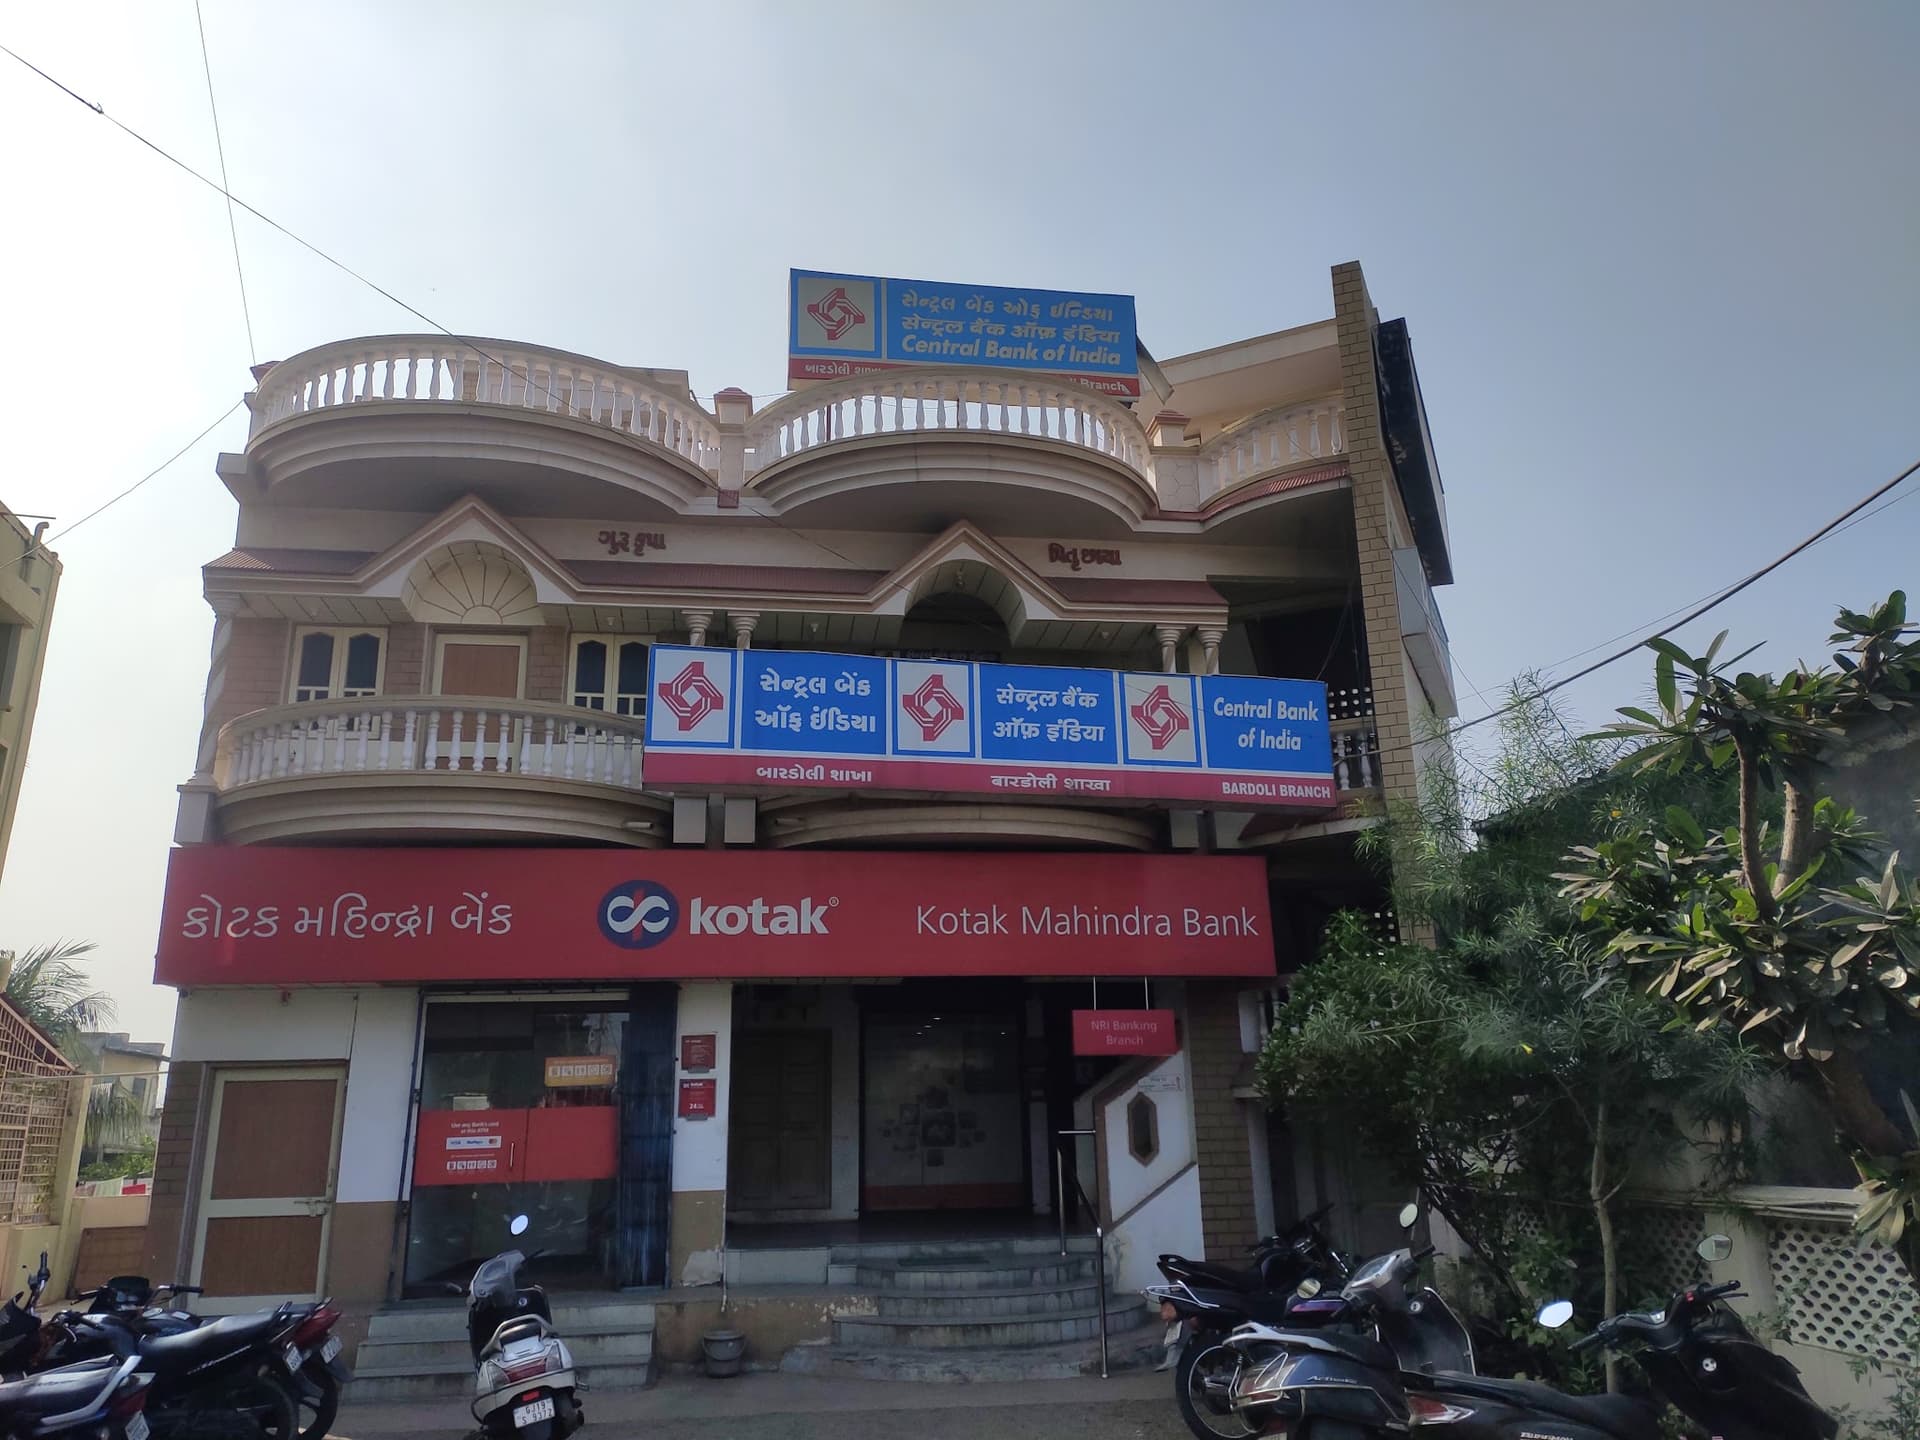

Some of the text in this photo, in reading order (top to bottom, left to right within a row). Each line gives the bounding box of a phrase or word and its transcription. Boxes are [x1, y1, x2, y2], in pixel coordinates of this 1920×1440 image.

[969, 317, 1007, 336] बैंक
[1062, 324, 1120, 344] इंडिया
[902, 334, 1121, 366] Central Bank of India
[804, 361, 850, 375] બારડોલી
[1080, 378, 1125, 392] Branch
[759, 667, 872, 699] સેન્ટ્રલ બેંક
[996, 683, 1099, 712] सेन्ट्रल बैंक
[1213, 696, 1320, 722] Central Bank
[755, 704, 876, 733] ઑફ ઈંડિયા
[1046, 718, 1106, 743] इंडिया
[1238, 727, 1302, 751] of India
[756, 764, 872, 783] બારડોલી શાખા
[990, 772, 1112, 792] बारडोली शाखा
[1222, 782, 1331, 799] BARDOLI BRANCH
[182, 891, 512, 939] કોટક મહિન્દ્રા બેંક
[689, 896, 829, 935] kotak
[917, 905, 1259, 937] Kotak Mahindra Bank
[1091, 1020, 1158, 1033] NRI Banking
[1106, 1035, 1144, 1045] Branch
